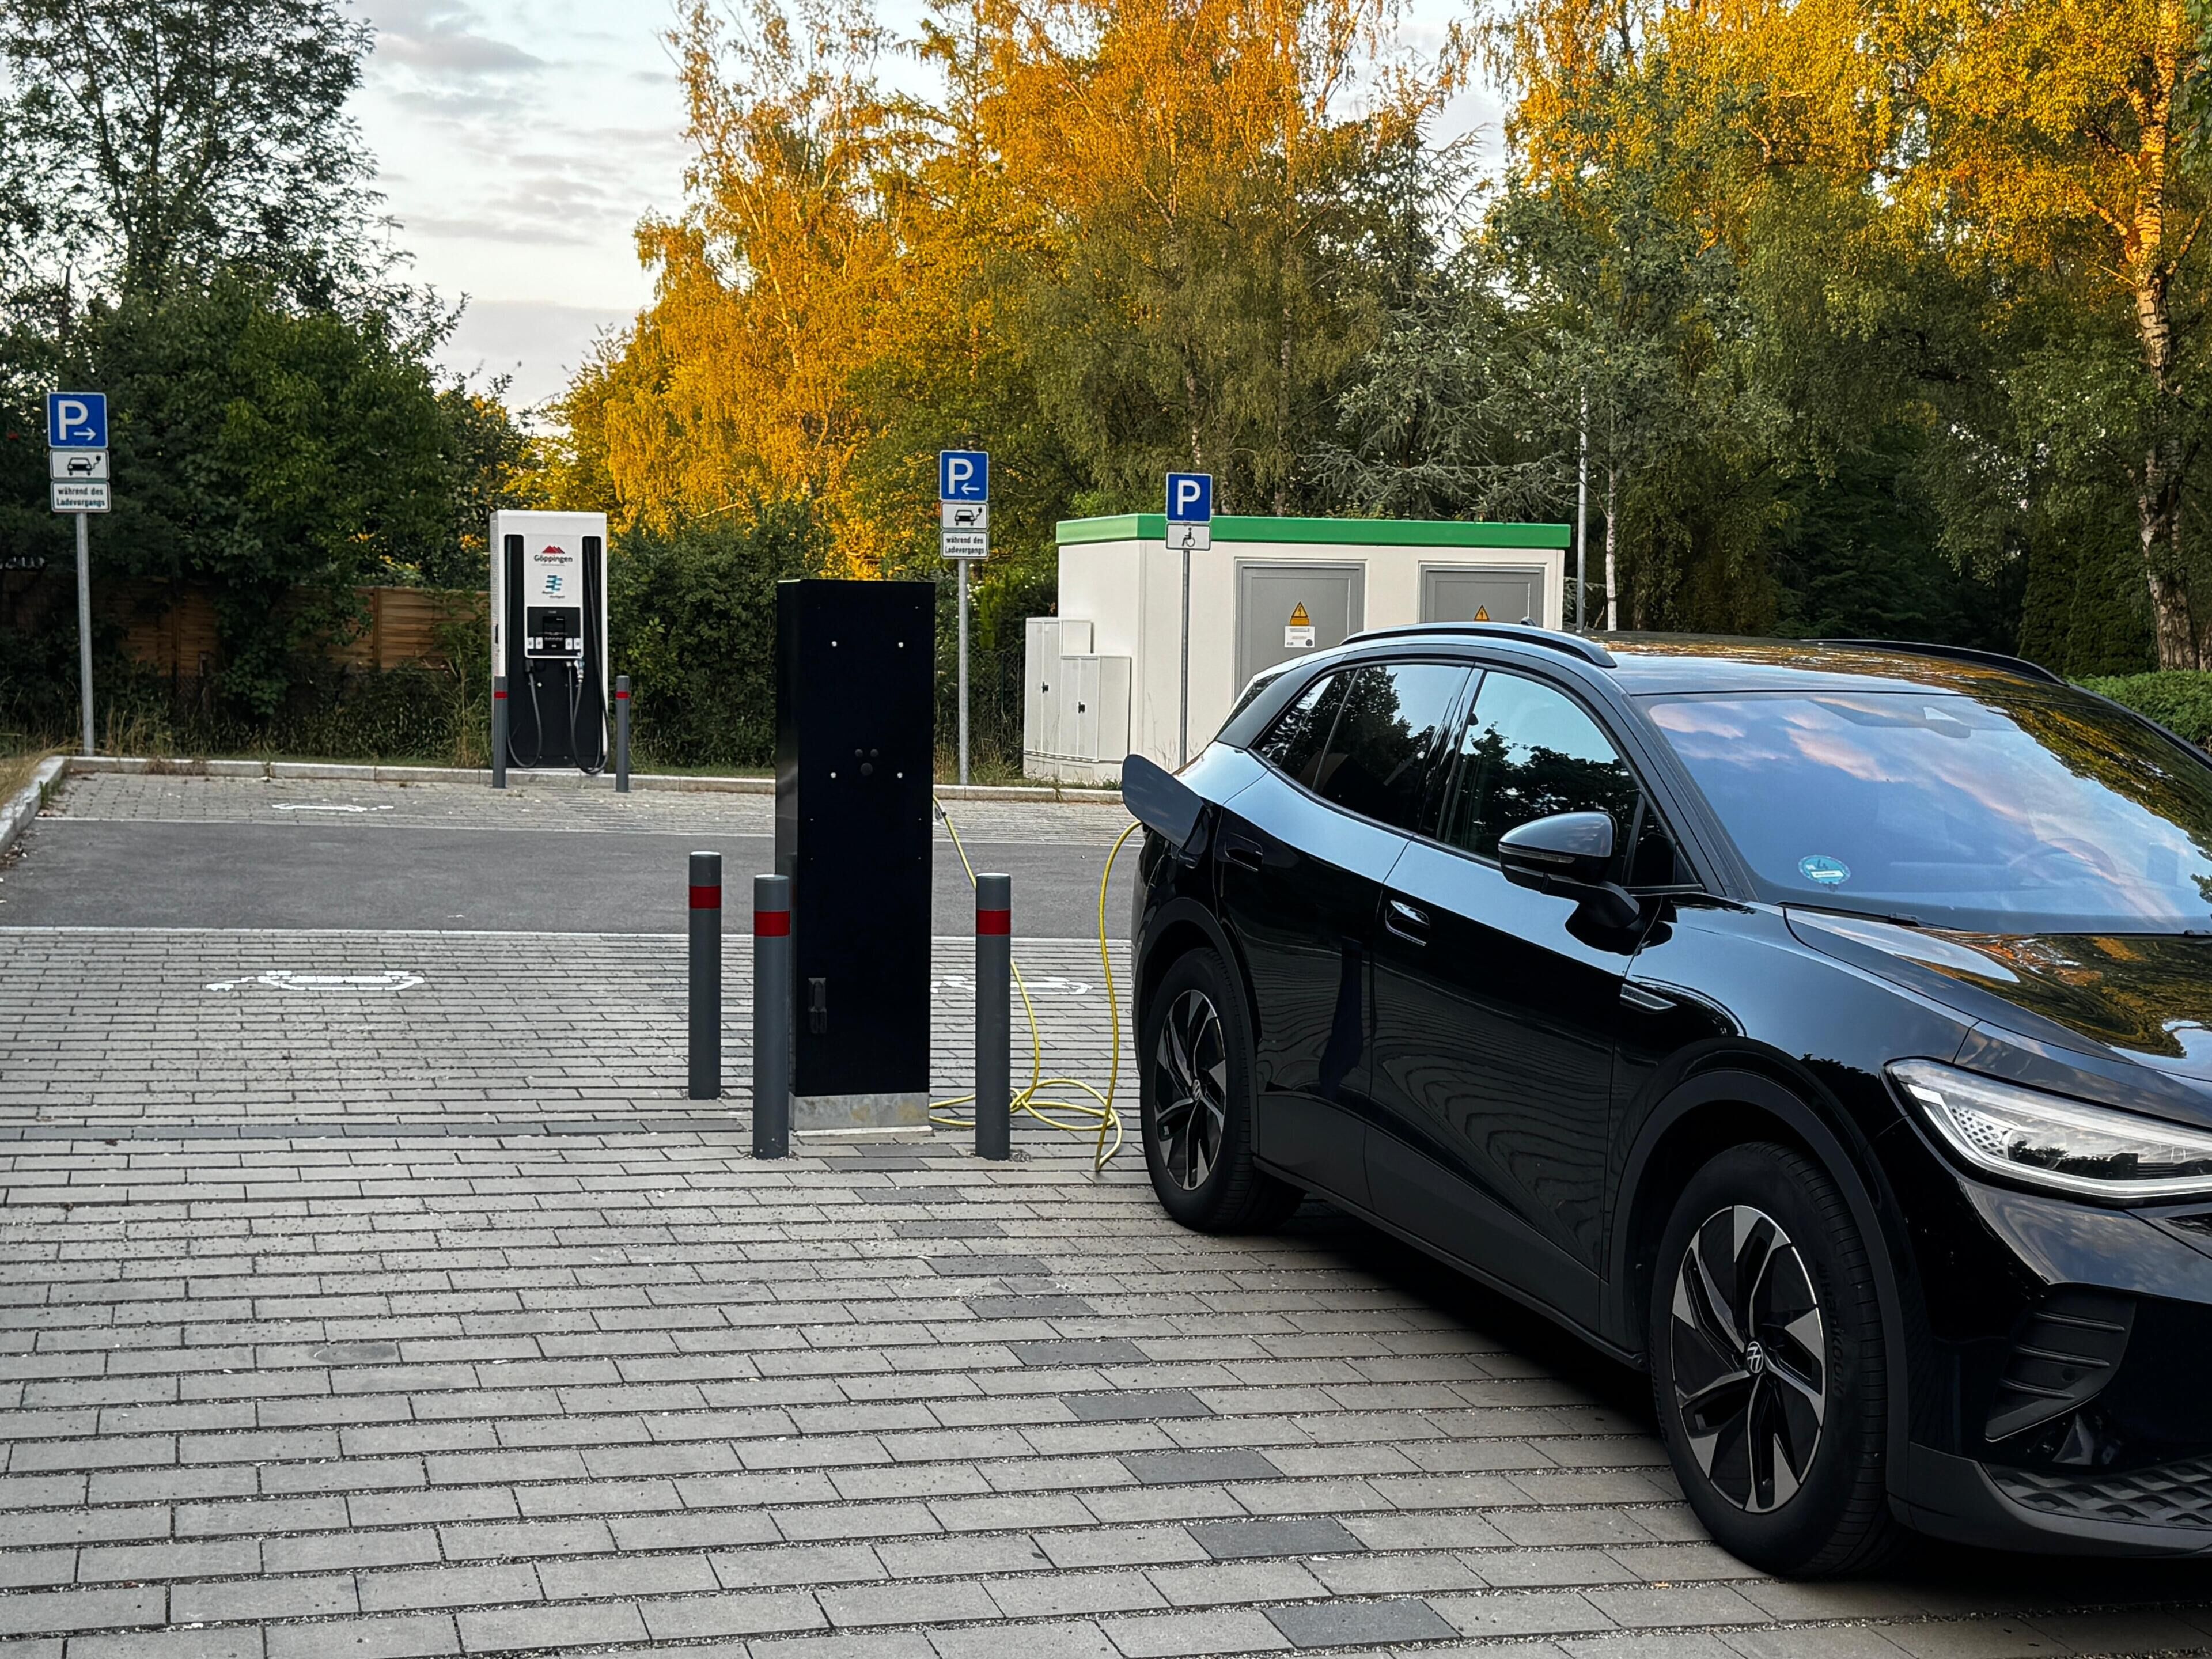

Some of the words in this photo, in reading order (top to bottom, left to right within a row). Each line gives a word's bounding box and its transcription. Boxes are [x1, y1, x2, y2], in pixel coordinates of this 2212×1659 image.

[59, 400, 88, 440] P
[949, 458, 974, 494] P
[56, 497, 105, 507] Ladevorgangs
[58, 486, 88, 495] während
[91, 487, 104, 495] des
[1177, 480, 1201, 516] P
[533, 554, 573, 564] Göppingen
